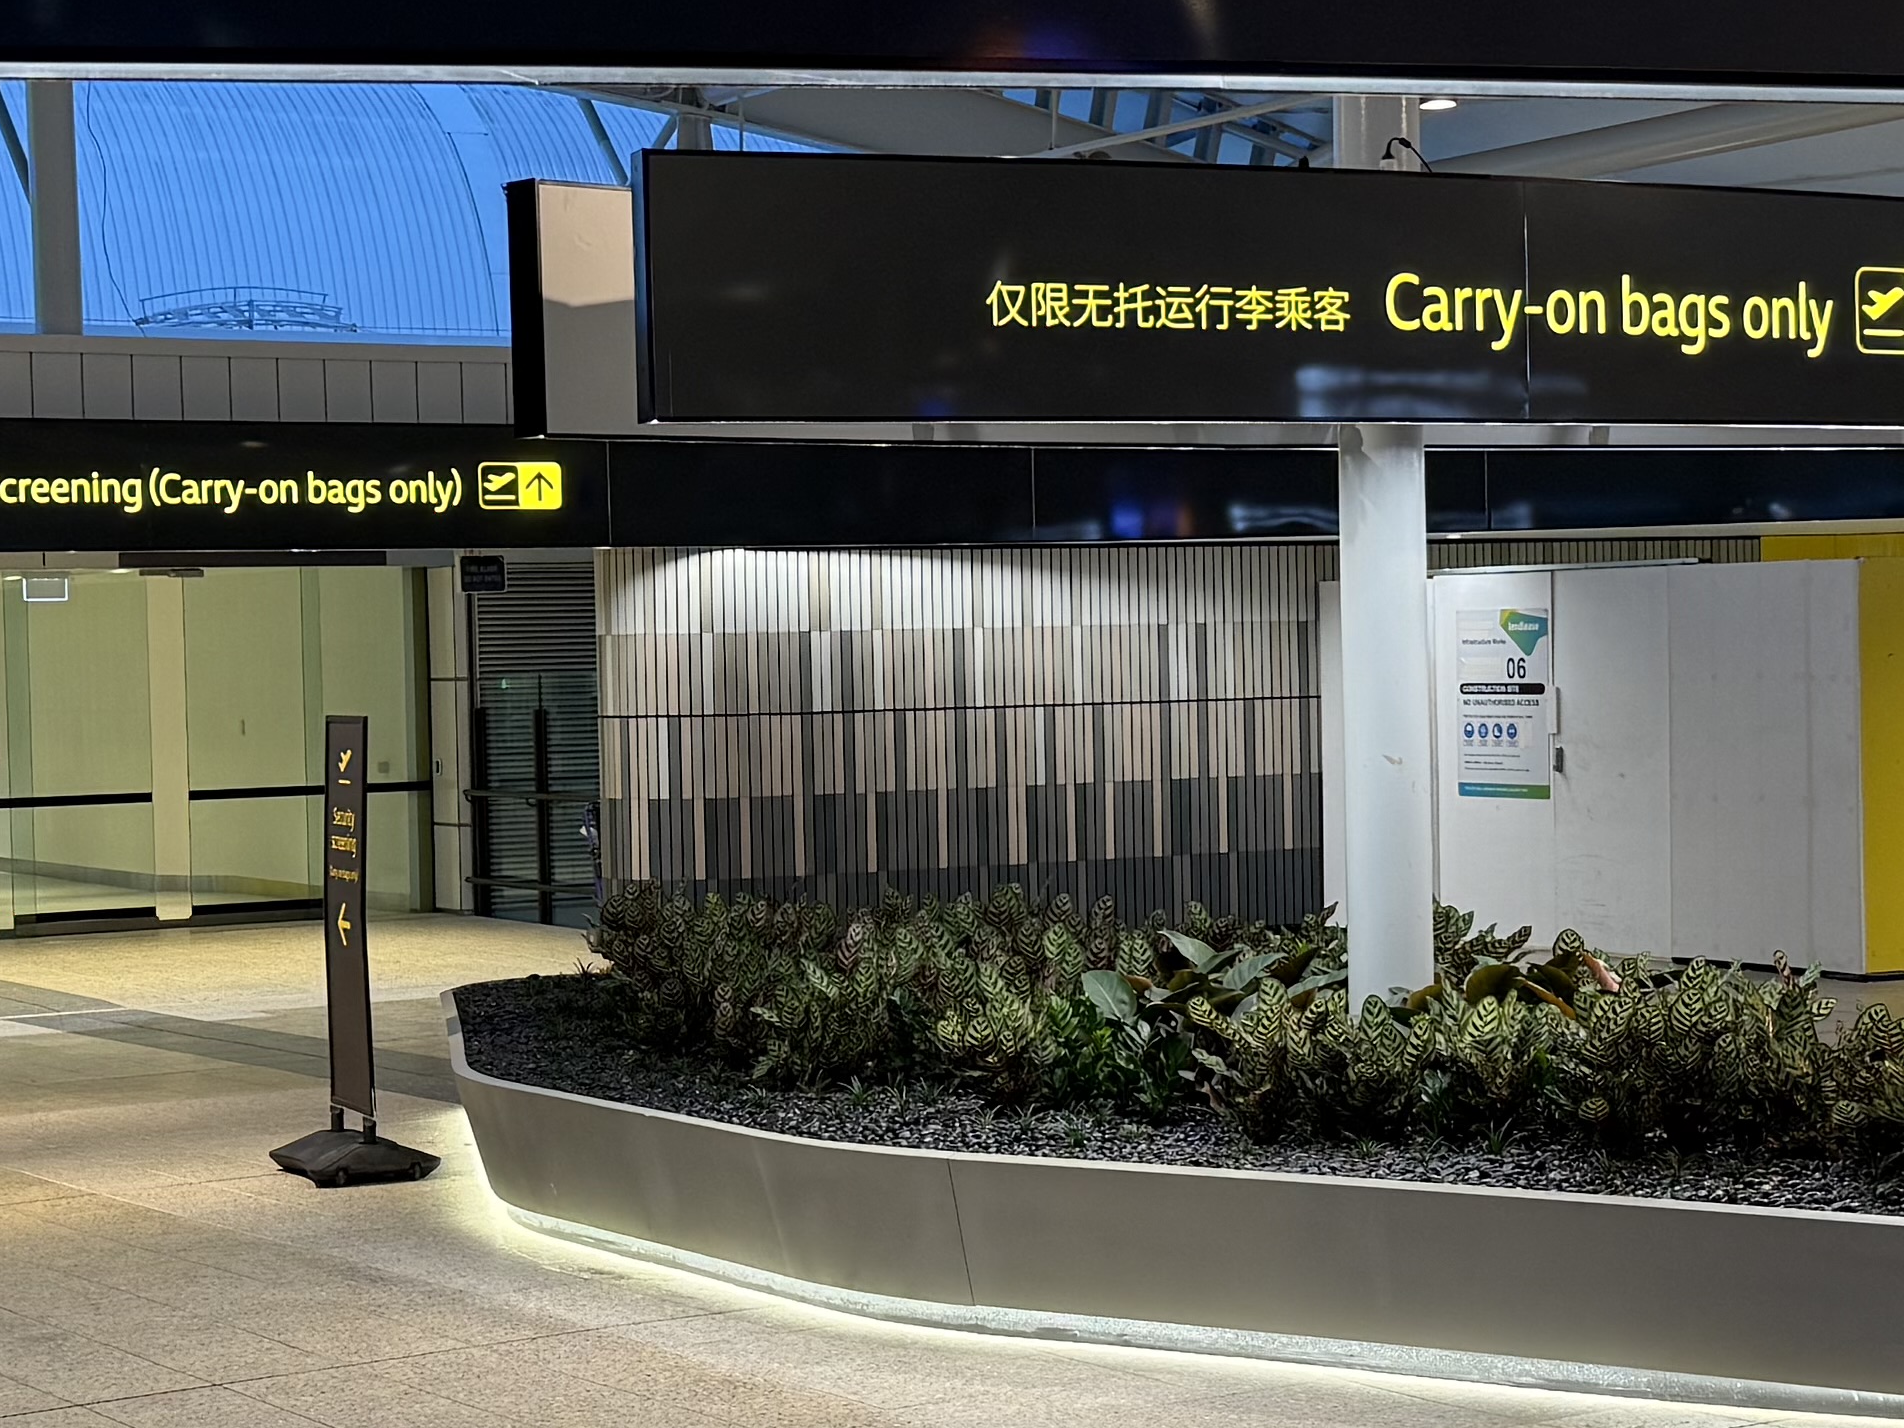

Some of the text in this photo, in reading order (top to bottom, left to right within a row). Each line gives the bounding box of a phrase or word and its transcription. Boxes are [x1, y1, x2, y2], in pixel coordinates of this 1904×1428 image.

[984, 280, 1351, 334] 仅限无托运行李乘客
[1384, 272, 1834, 358] Carry-on bags only
[146, 468, 299, 513] (Carry-on
[307, 470, 382, 514] bags
[388, 468, 463, 514] only)
[1506, 657, 1527, 679] 06
